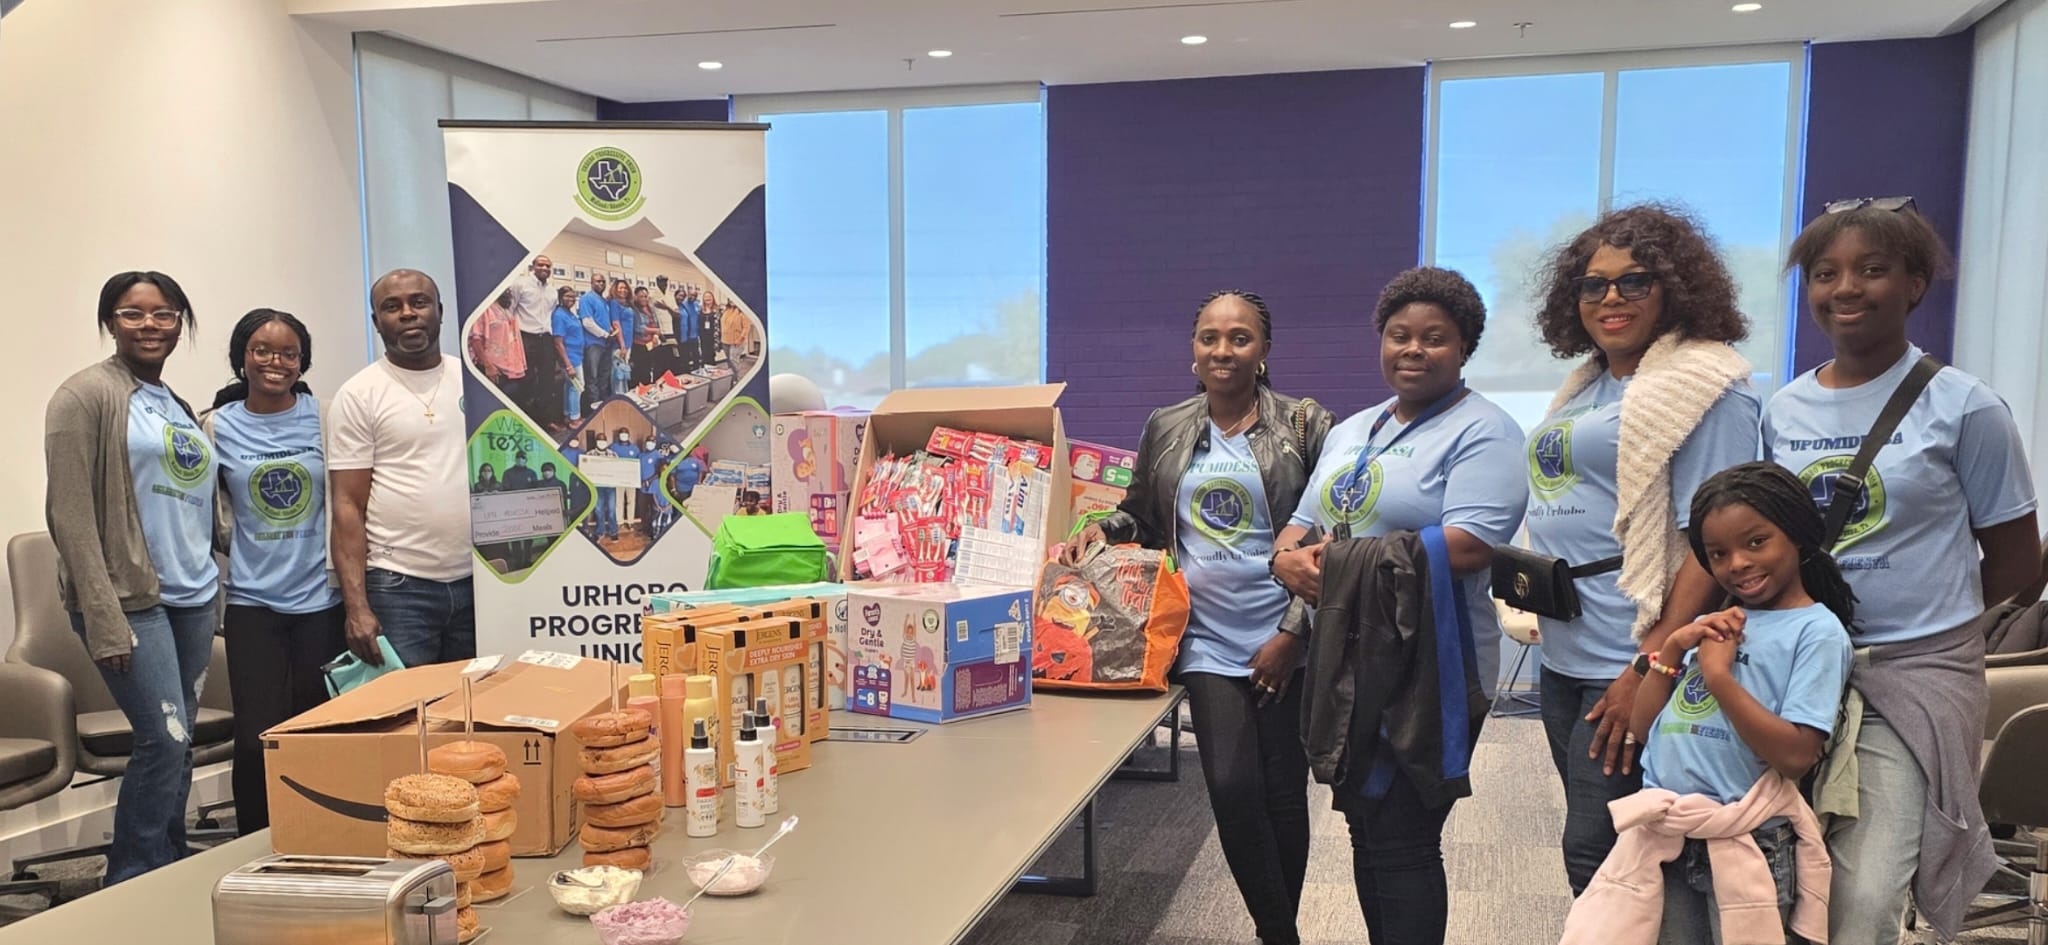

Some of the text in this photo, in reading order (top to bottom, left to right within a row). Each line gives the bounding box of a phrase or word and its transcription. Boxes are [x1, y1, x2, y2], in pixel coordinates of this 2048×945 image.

[1790, 432, 1903, 451] UPUMIDA
[1017, 475, 1028, 508] Aim
[530, 613, 641, 638] PROGRE
[861, 628, 883, 638] Dry &
[859, 637, 884, 648] Gentle
[580, 642, 641, 664] UNI
[656, 641, 671, 676] JERG
[705, 644, 721, 676] JERG
[749, 648, 771, 658] DEEPLY
[750, 652, 796, 666] EXTRA DRY SKIN
[867, 692, 875, 706] 8
